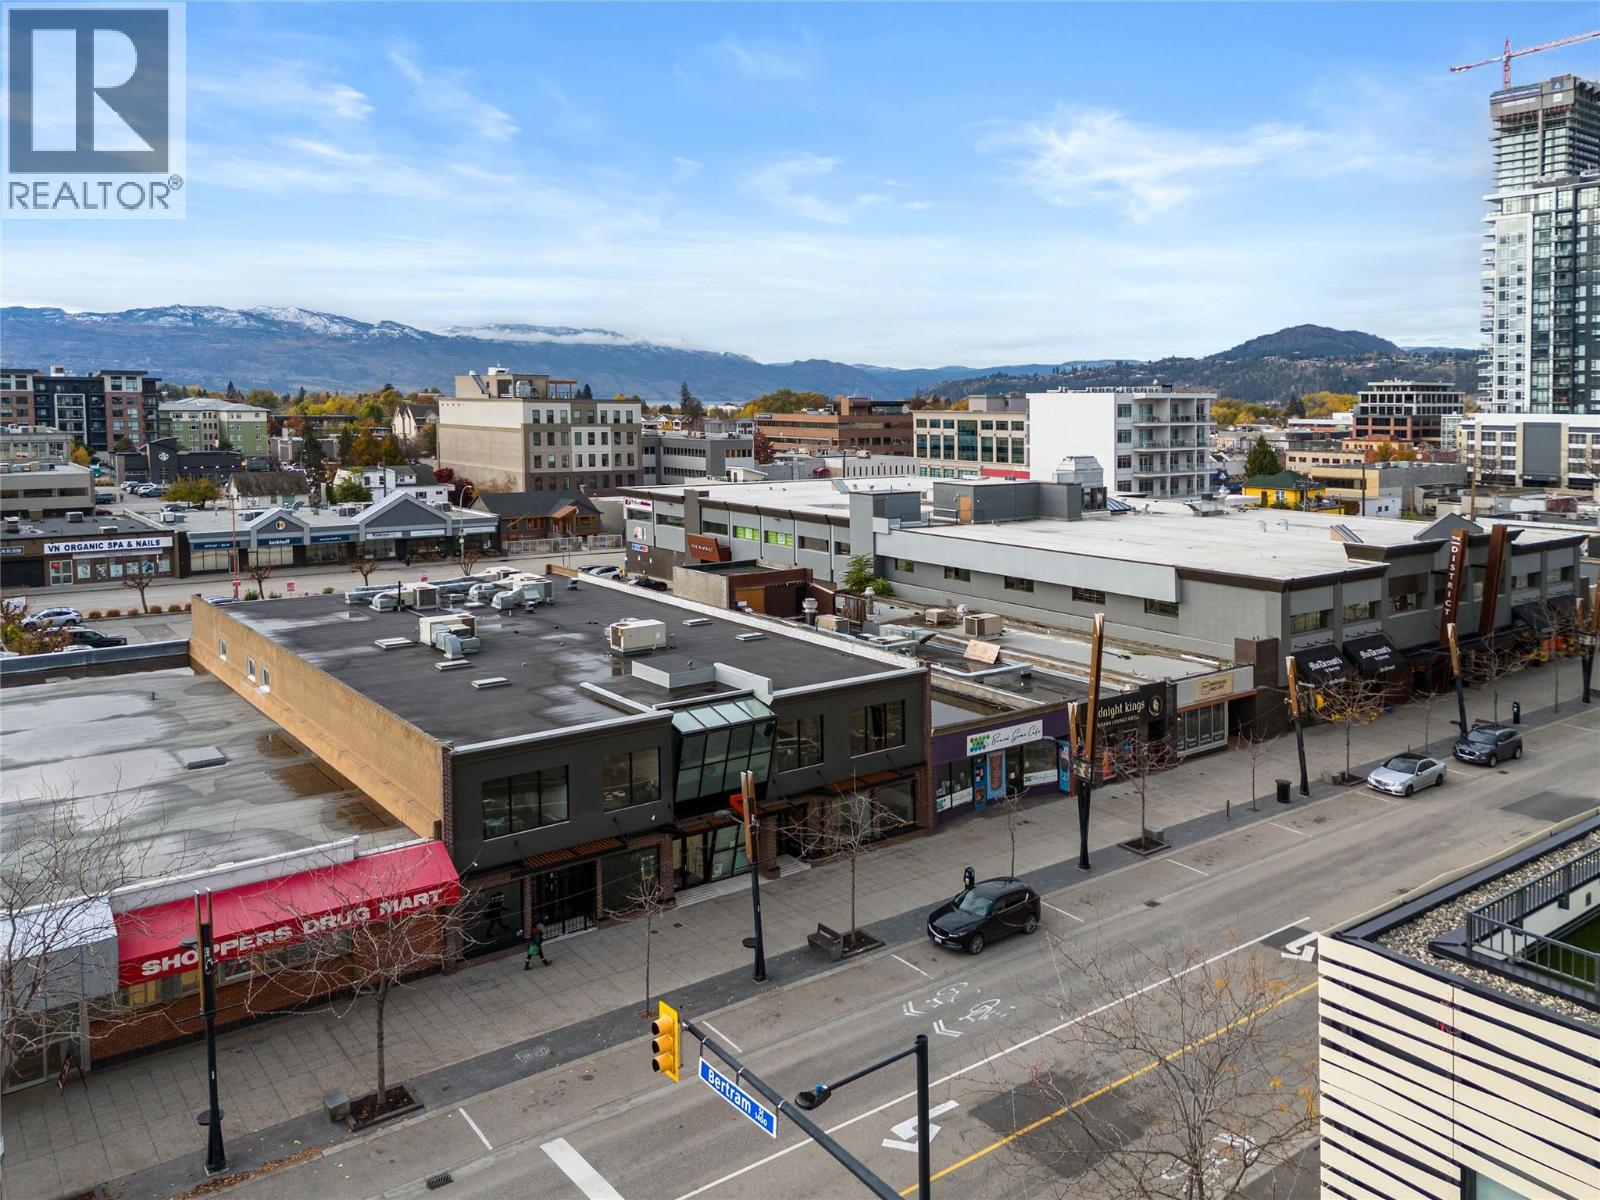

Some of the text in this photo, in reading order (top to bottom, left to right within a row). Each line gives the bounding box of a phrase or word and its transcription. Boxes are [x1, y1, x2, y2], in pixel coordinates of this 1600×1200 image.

[48, 539, 161, 553] VN ORGANIC SPA & NAILS
[1444, 545, 1459, 615] DISTRICT
[1098, 701, 1145, 719] dnight kings
[302, 906, 371, 935] DRUG
[379, 889, 442, 916] MART
[708, 1068, 751, 1114] Bertram
